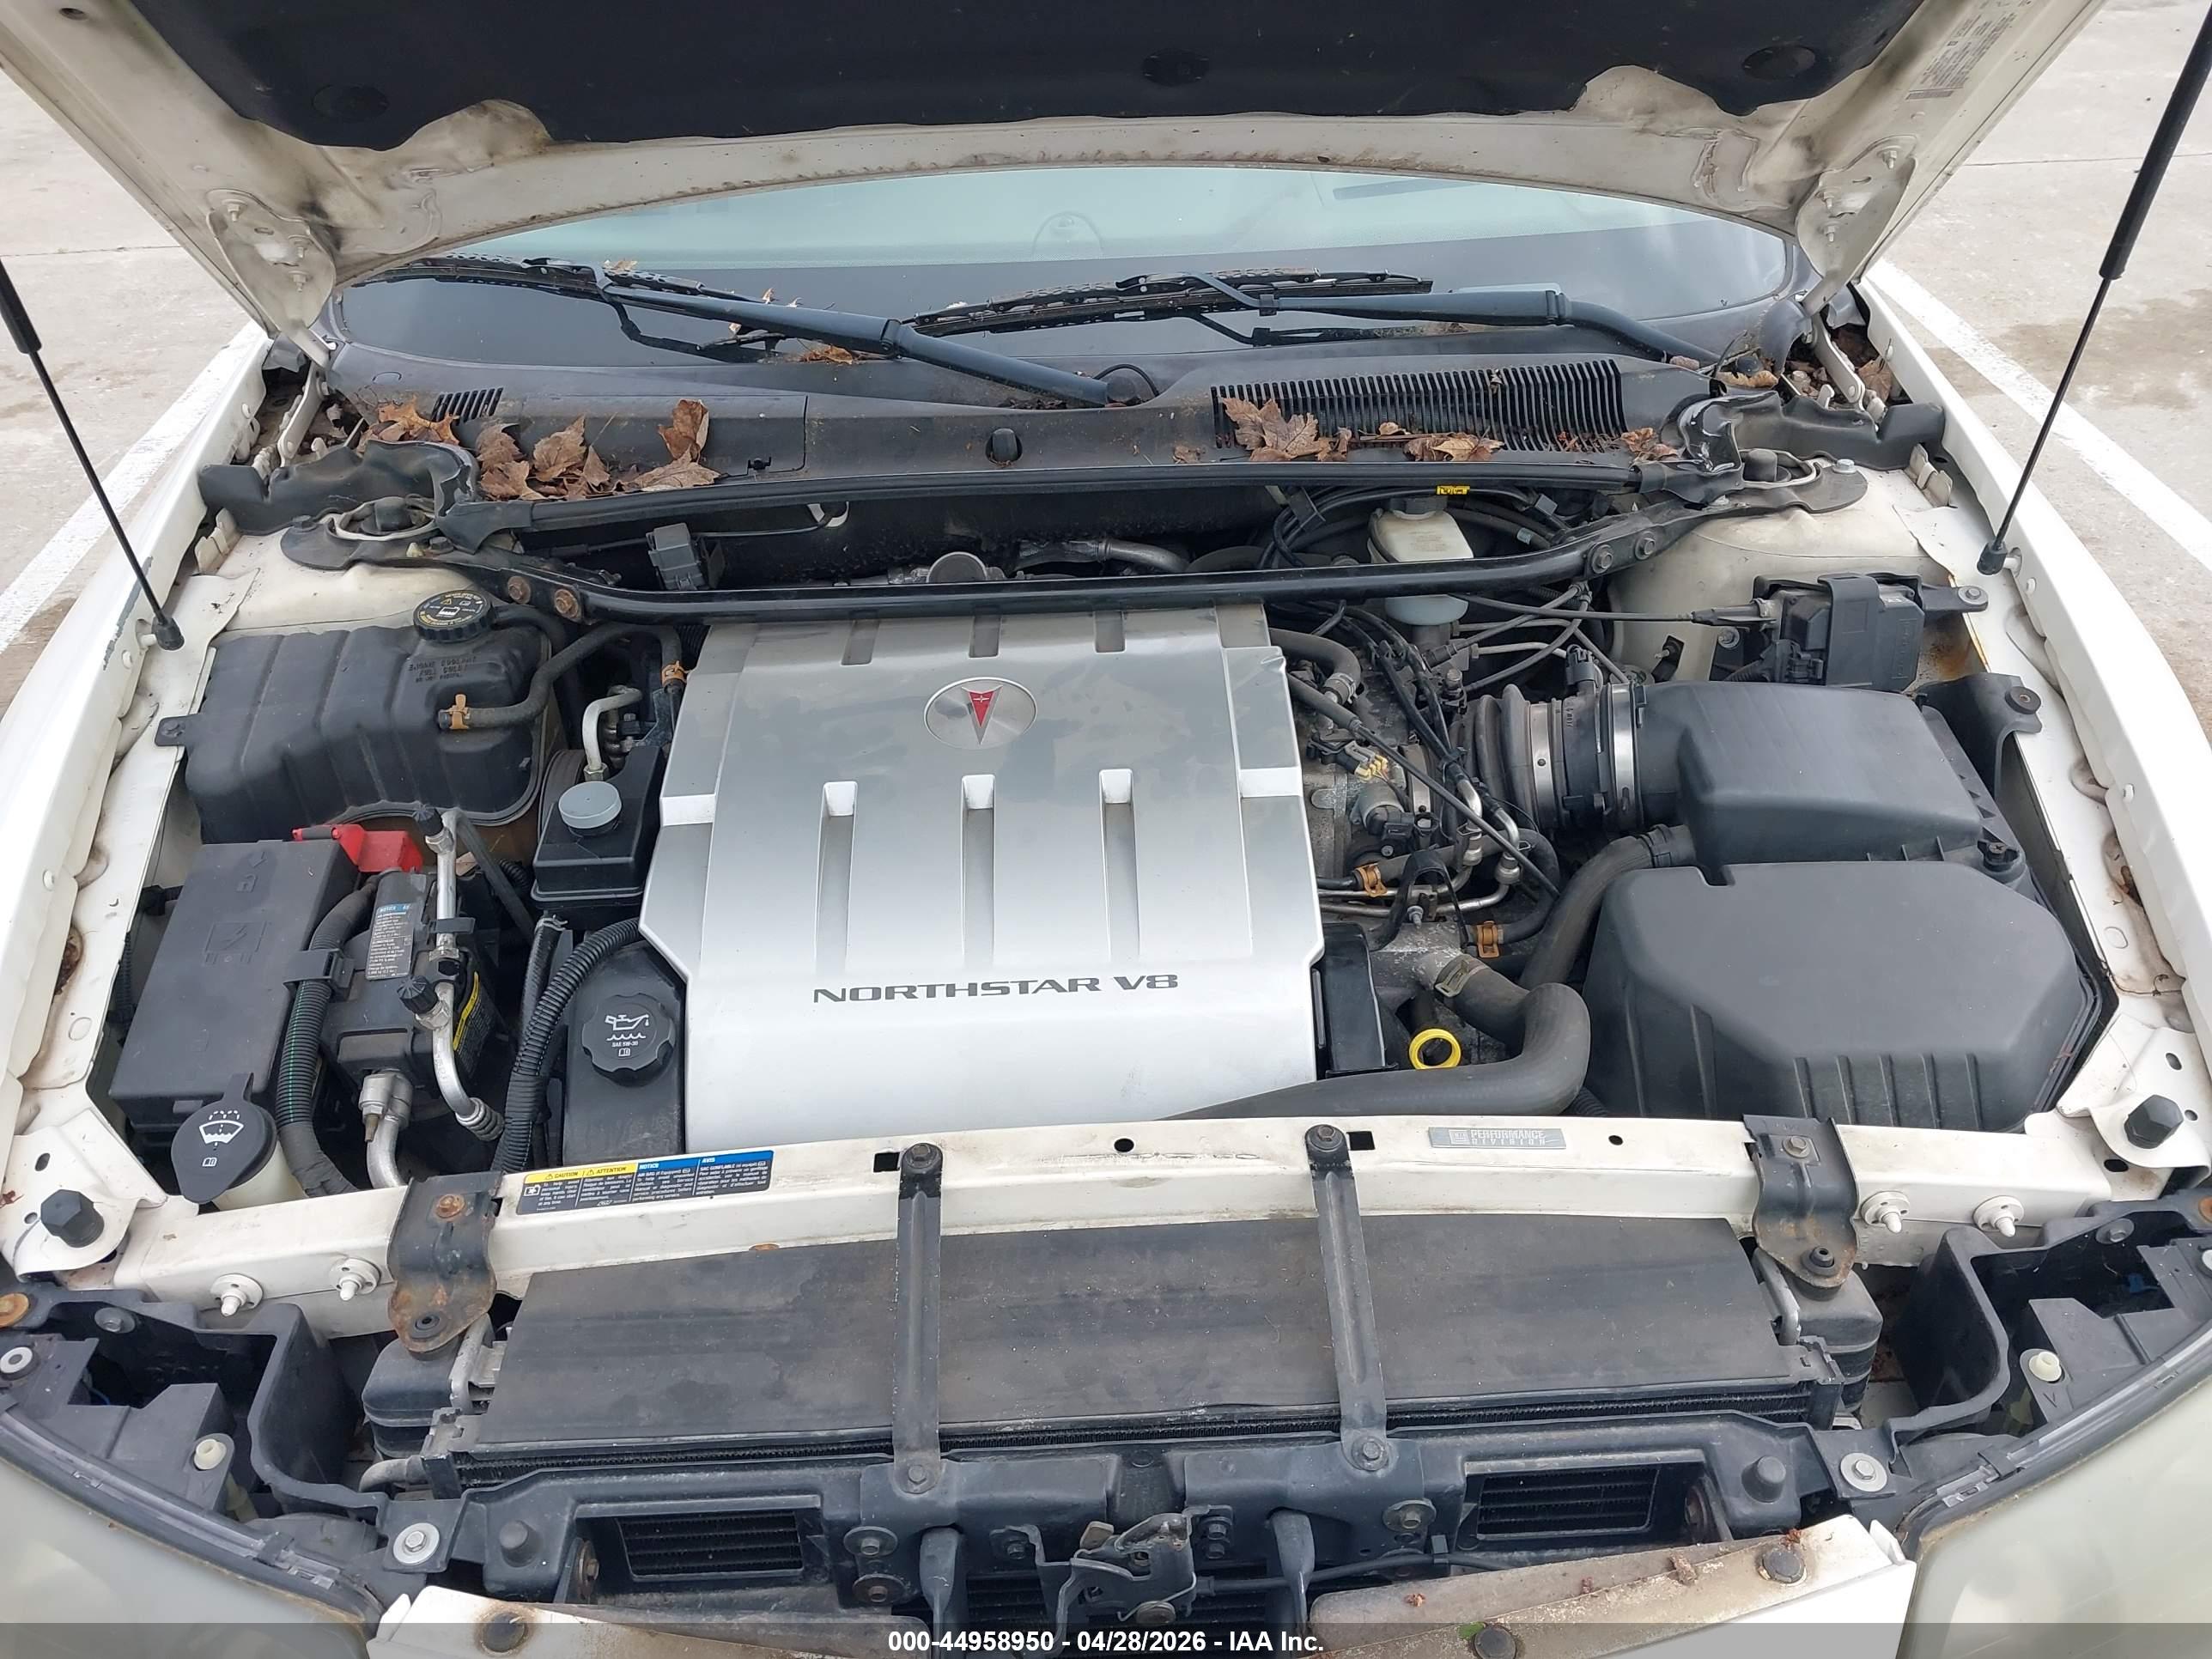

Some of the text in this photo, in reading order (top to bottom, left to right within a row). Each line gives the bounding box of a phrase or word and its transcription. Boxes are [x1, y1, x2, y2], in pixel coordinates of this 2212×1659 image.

[813, 974, 1178, 1004] NORTHSTAR V8
[1470, 1129, 1547, 1139] PERFORMANCE
